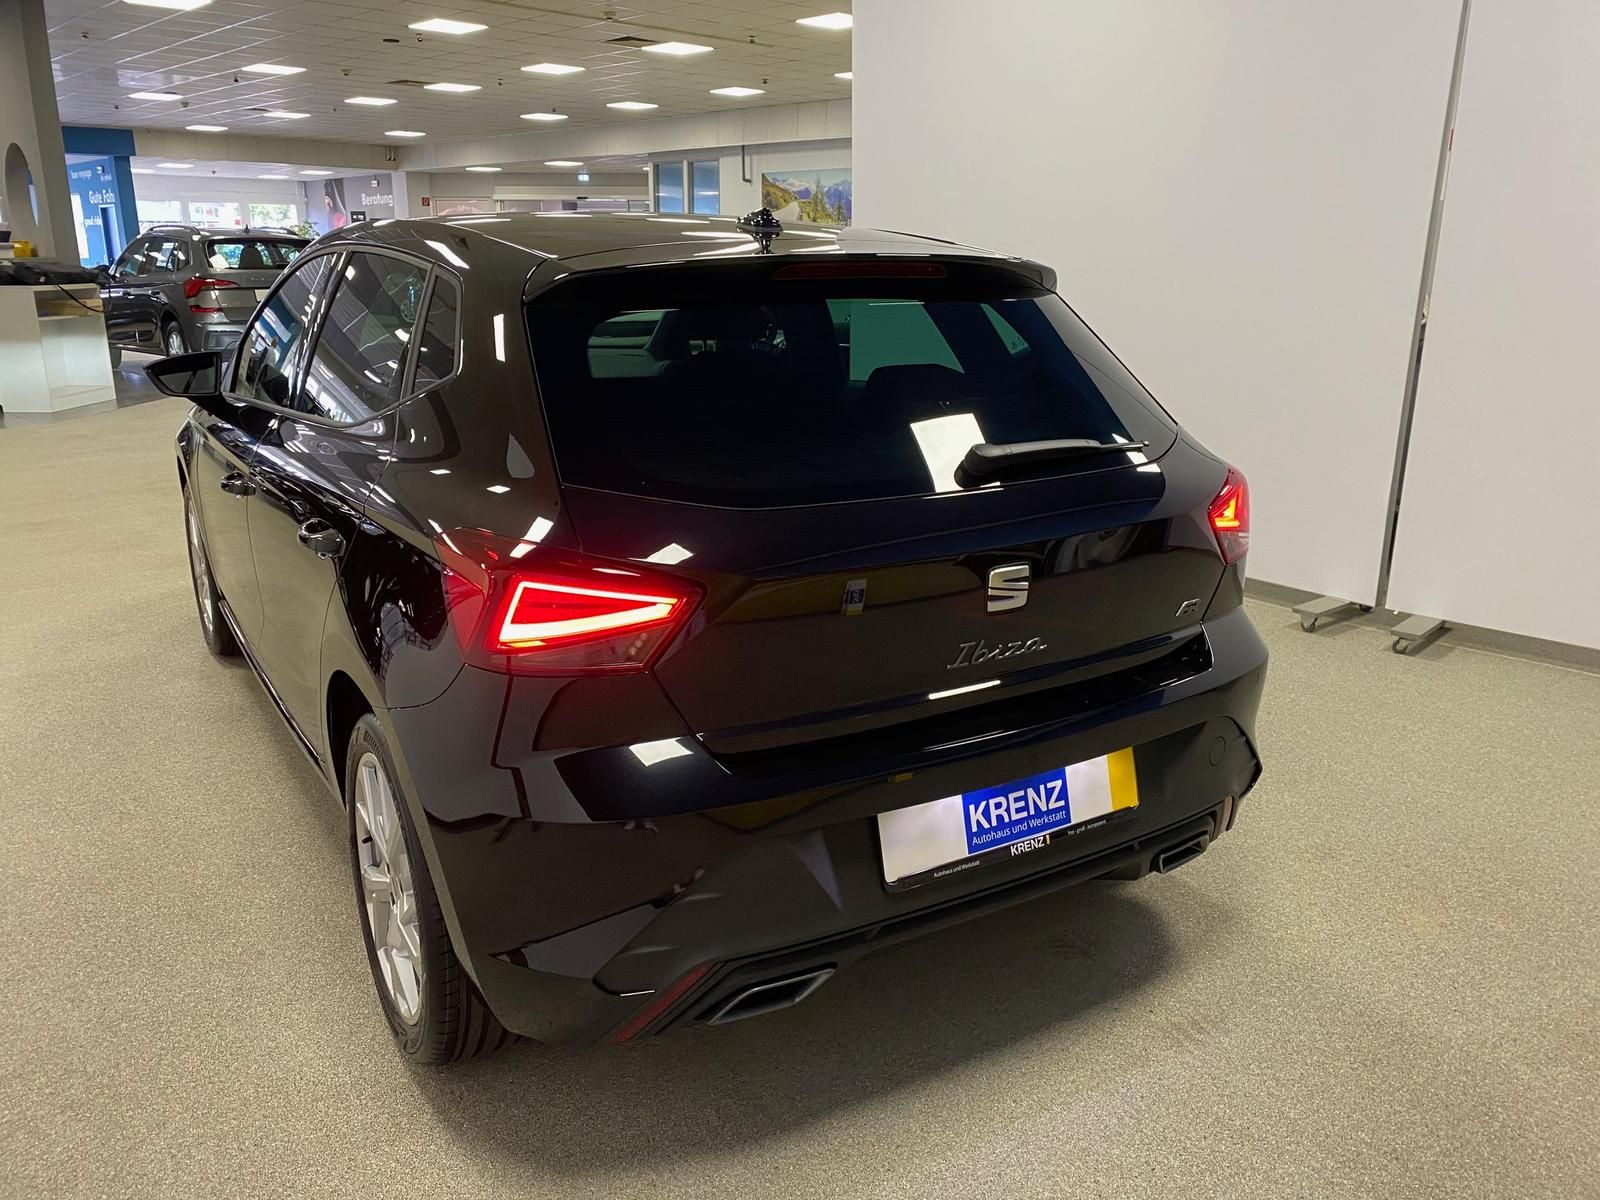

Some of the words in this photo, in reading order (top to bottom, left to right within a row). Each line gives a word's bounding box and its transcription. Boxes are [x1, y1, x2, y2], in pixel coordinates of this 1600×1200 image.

[361, 193, 394, 207] Beratung
[946, 636, 1048, 670] Ibiza
[968, 779, 1066, 833] KRENZ
[971, 827, 1011, 846] Autohaus
[1011, 822, 1028, 834] und
[1028, 810, 1067, 829] Werkstatt
[1009, 836, 1046, 858] KRENZ
[933, 867, 953, 878] Autohaus
[952, 865, 962, 873] und
[961, 860, 981, 870] Werkstatt
